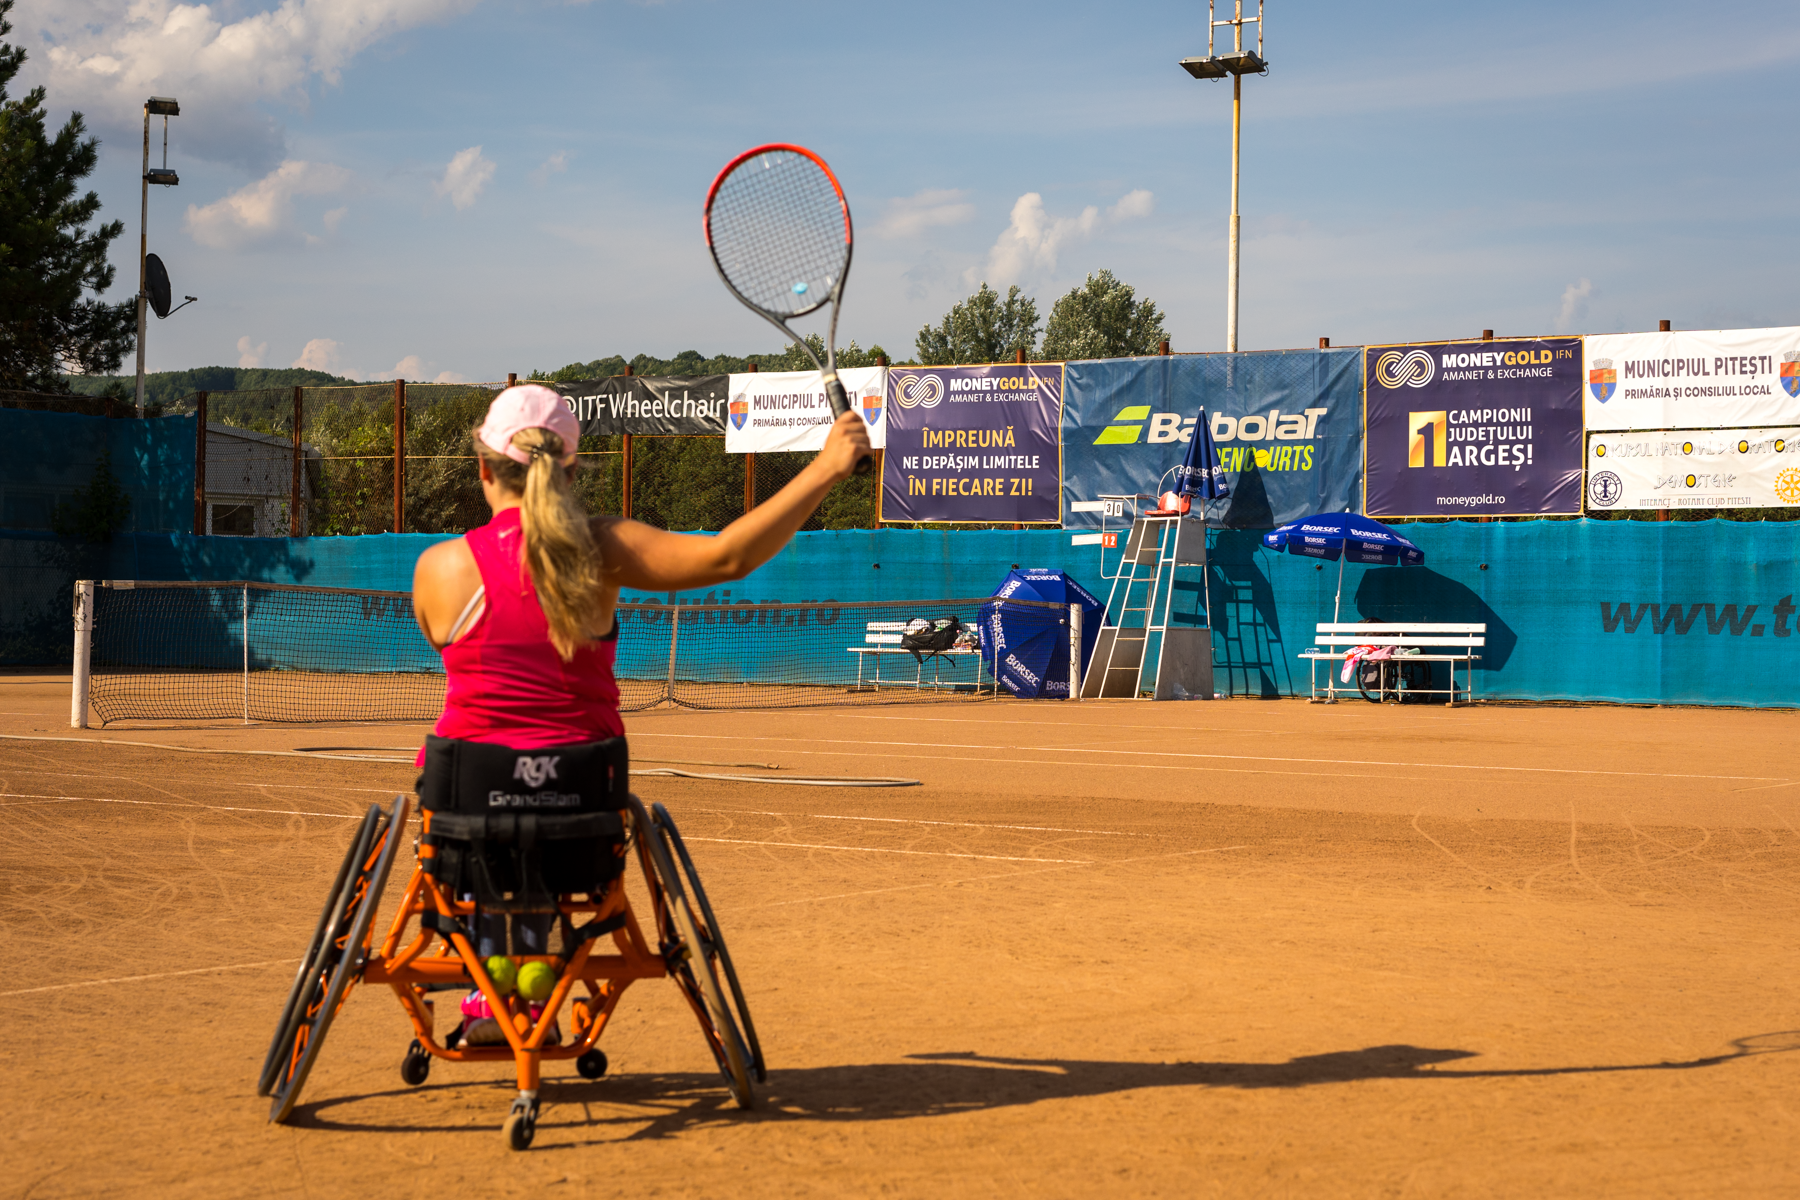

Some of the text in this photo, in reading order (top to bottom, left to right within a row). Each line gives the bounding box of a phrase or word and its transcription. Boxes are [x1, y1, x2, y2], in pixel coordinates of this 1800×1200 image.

[1442, 349, 1573, 368] MONEYGOLD IFN
[1442, 367, 1553, 381] AMANET & EXCHANGE
[1624, 355, 1772, 380] MUNICIPIUL PITEȘTI
[950, 376, 1038, 392] MONEYGOLD
[1624, 385, 1671, 400] PRIMĂRIA
[1684, 385, 1737, 398] CONSILIUL
[1739, 384, 1771, 396] LOCAL
[753, 390, 858, 411] MUNICIPIUL PITI
[949, 392, 1038, 403] AMANET & EXCHANGE
[753, 415, 788, 428] PRIMĂRIA
[796, 415, 833, 426] CONSILIUL
[1448, 408, 1532, 424] CAMPIONII
[921, 426, 1016, 448] ÎMPREUNĂ
[1448, 425, 1533, 445] JUDEȚULUI
[903, 453, 1040, 473] NE DEPĂȘIM LIMITELE
[1447, 443, 1533, 472] ARGEȘ!
[908, 475, 1033, 496] ÎN FIECARE ZI!
[1436, 494, 1506, 507] moneygold.ro
[1300, 524, 1342, 534] BORSEC
[1350, 528, 1392, 541] BORSEC
[1304, 536, 1327, 545] BORSEC
[1362, 542, 1385, 551] BORSEC
[1600, 594, 1800, 638] www.t
[1005, 653, 1040, 687] BORSEC
[1046, 680, 1071, 691] BORS
